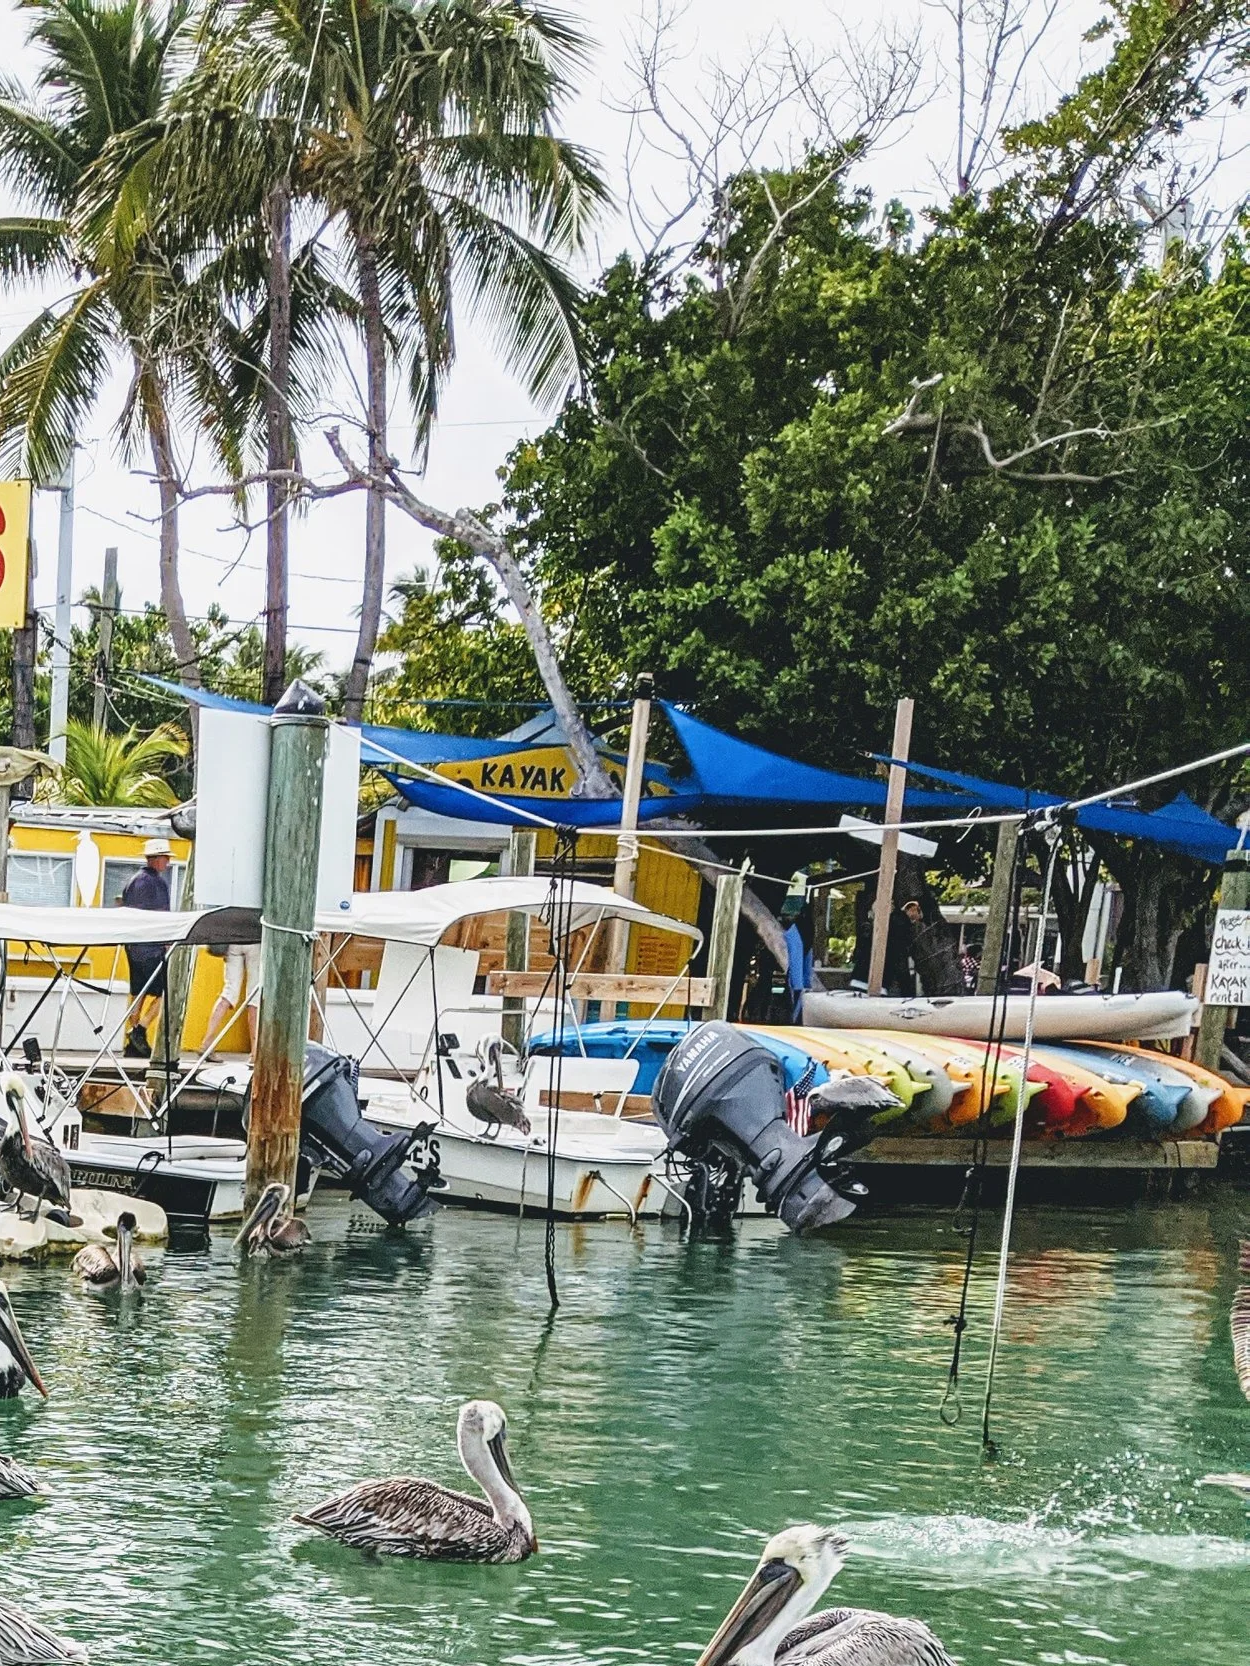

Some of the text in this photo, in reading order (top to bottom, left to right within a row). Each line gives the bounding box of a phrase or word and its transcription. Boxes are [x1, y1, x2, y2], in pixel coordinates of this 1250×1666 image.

[481, 763, 566, 793] KAYAK
[1211, 973, 1248, 991] KAYAK
[675, 1030, 720, 1073] YAMAHA
